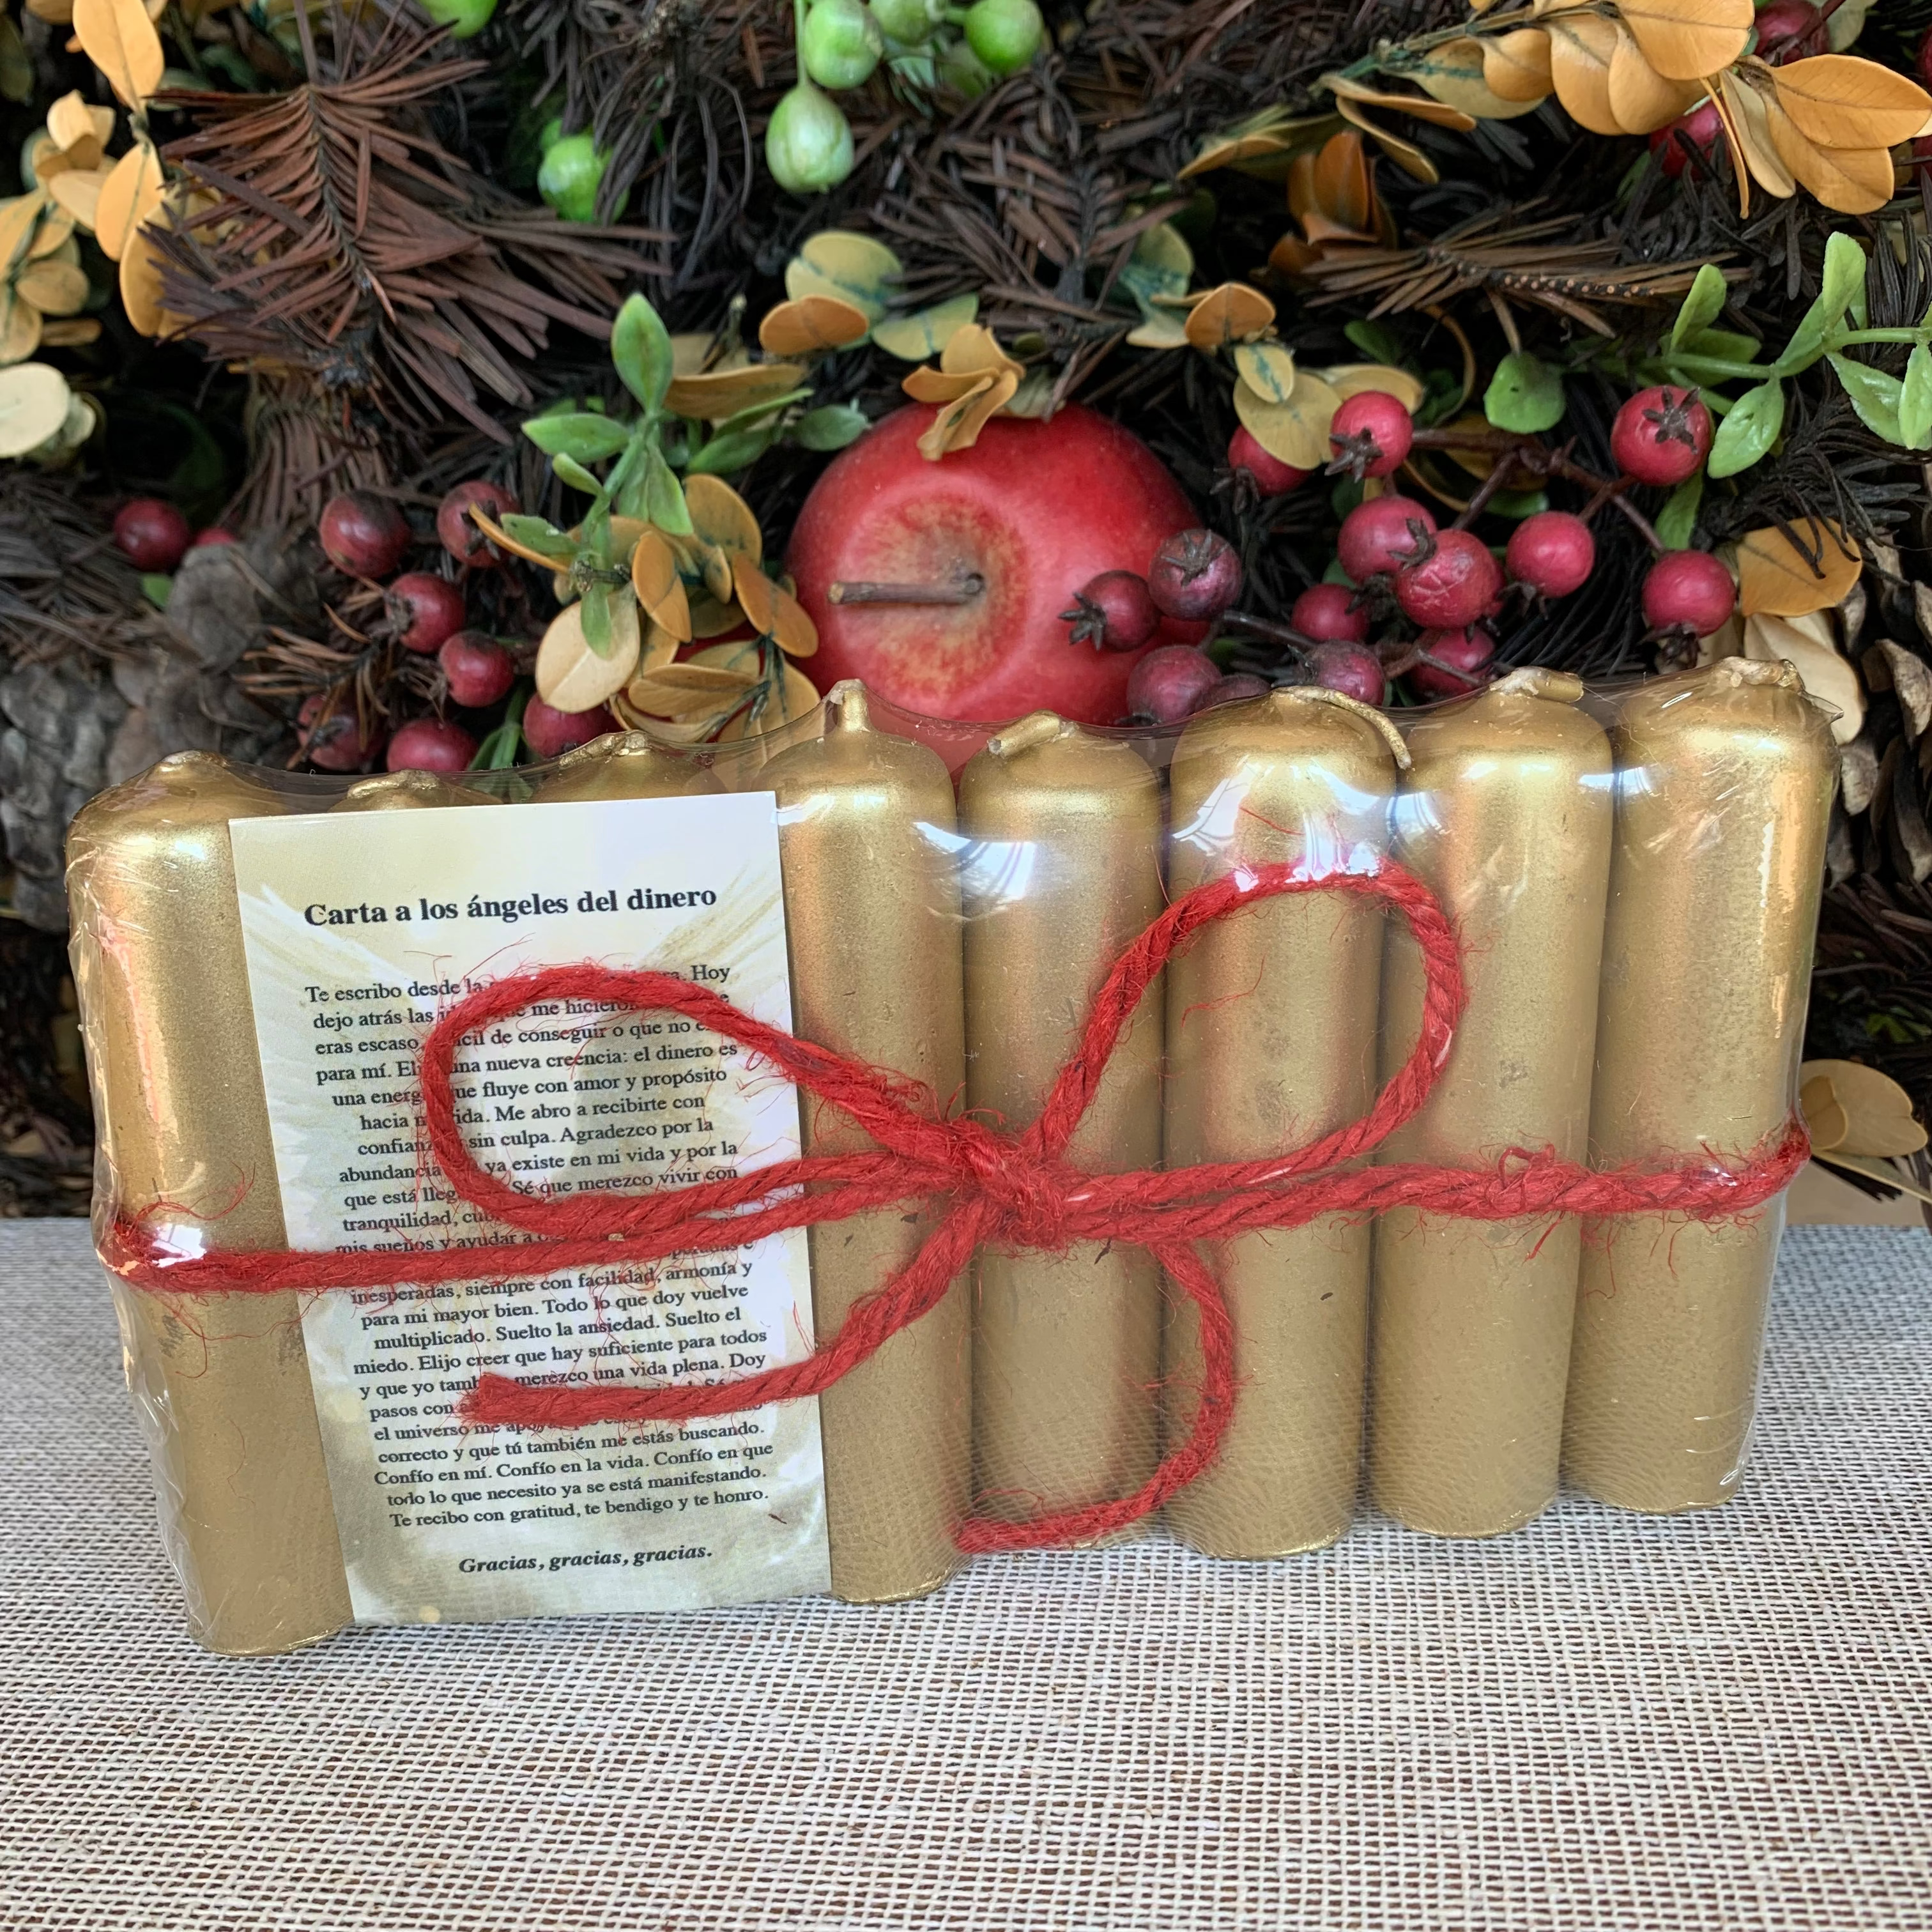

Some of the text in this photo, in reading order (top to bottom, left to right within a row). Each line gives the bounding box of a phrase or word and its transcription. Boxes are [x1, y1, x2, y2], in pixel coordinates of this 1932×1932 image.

[304, 888, 717, 926] Carta a los ángeles del dinero
[304, 986, 330, 1003] Te
[334, 983, 402, 1001] escribo
[407, 979, 461, 997] desde
[690, 964, 730, 983] Hoy
[313, 1011, 353, 1032] dejo
[358, 1009, 402, 1026] atrás
[407, 1008, 435, 1025] las
[530, 1004, 560, 1016] me
[315, 1042, 353, 1055] eras
[490, 1029, 513, 1045] de
[518, 1025, 606, 1043] conseguir
[611, 1025, 624, 1038] o
[629, 1022, 663, 1040] que
[667, 1022, 691, 1034] no
[315, 1068, 356, 1086] para
[361, 1062, 392, 1079] mí.
[486, 1058, 540, 1071] nueva
[546, 1048, 629, 1068] creencia:
[632, 1046, 651, 1062] el
[655, 1044, 714, 1061] dinero
[718, 1044, 738, 1056] es
[331, 1067, 727, 1108] una energ ue fluye con amor y propósito
[359, 1114, 410, 1130] hacia
[453, 1108, 490, 1124] ida.
[494, 1105, 525, 1121] Me
[531, 1103, 571, 1119] abro
[576, 1105, 588, 1116] a
[592, 1098, 668, 1116] recibirte
[672, 1097, 706, 1109] con
[467, 1133, 496, 1148] sin
[500, 1130, 555, 1149] culpa.
[560, 1123, 657, 1145] Agradezco
[661, 1123, 693, 1139] por
[696, 1117, 714, 1132] la
[339, 1140, 738, 1185] abundancia ya existe en mi vida y por la
[344, 1195, 377, 1211] que
[382, 1188, 416, 1204] está
[577, 1174, 654, 1193] merezco
[657, 1165, 701, 1185] vivir
[703, 1165, 739, 1181] con
[342, 1209, 458, 1232] tranquilidad,
[352, 1261, 752, 1304] inesperadas, siempre con facilidad, armonía y
[360, 1285, 748, 1331] para mi mayor bien. Todo lo que doy vuelve
[374, 1307, 741, 1350] multiplicado. Suelto la ansiedad. Suelto el
[353, 1330, 767, 1374] miedo. Elijo creer que hay suficiente para todos
[359, 1386, 371, 1401] y
[376, 1384, 408, 1399] que
[411, 1383, 434, 1397] yo
[514, 1371, 588, 1387] merezco
[592, 1368, 625, 1383] una
[629, 1361, 668, 1377] vida
[672, 1358, 724, 1377] plena.
[729, 1353, 765, 1369] Doy
[369, 1406, 418, 1423] pasos
[422, 1404, 454, 1415] con
[374, 1427, 391, 1441] el
[394, 1424, 471, 1439] universo
[378, 1421, 765, 1463] correcto y que tú también me estás buscando.
[373, 1445, 773, 1485] Confío en mí. Confío en la vida. Confío en que
[386, 1466, 766, 1506] todo lo que necesito ya se está manifestando.
[388, 1491, 769, 1528] Te recibo con gratitud, te bendigo y te honro.
[459, 1545, 712, 1573] Gracias, gracias, gracias.
